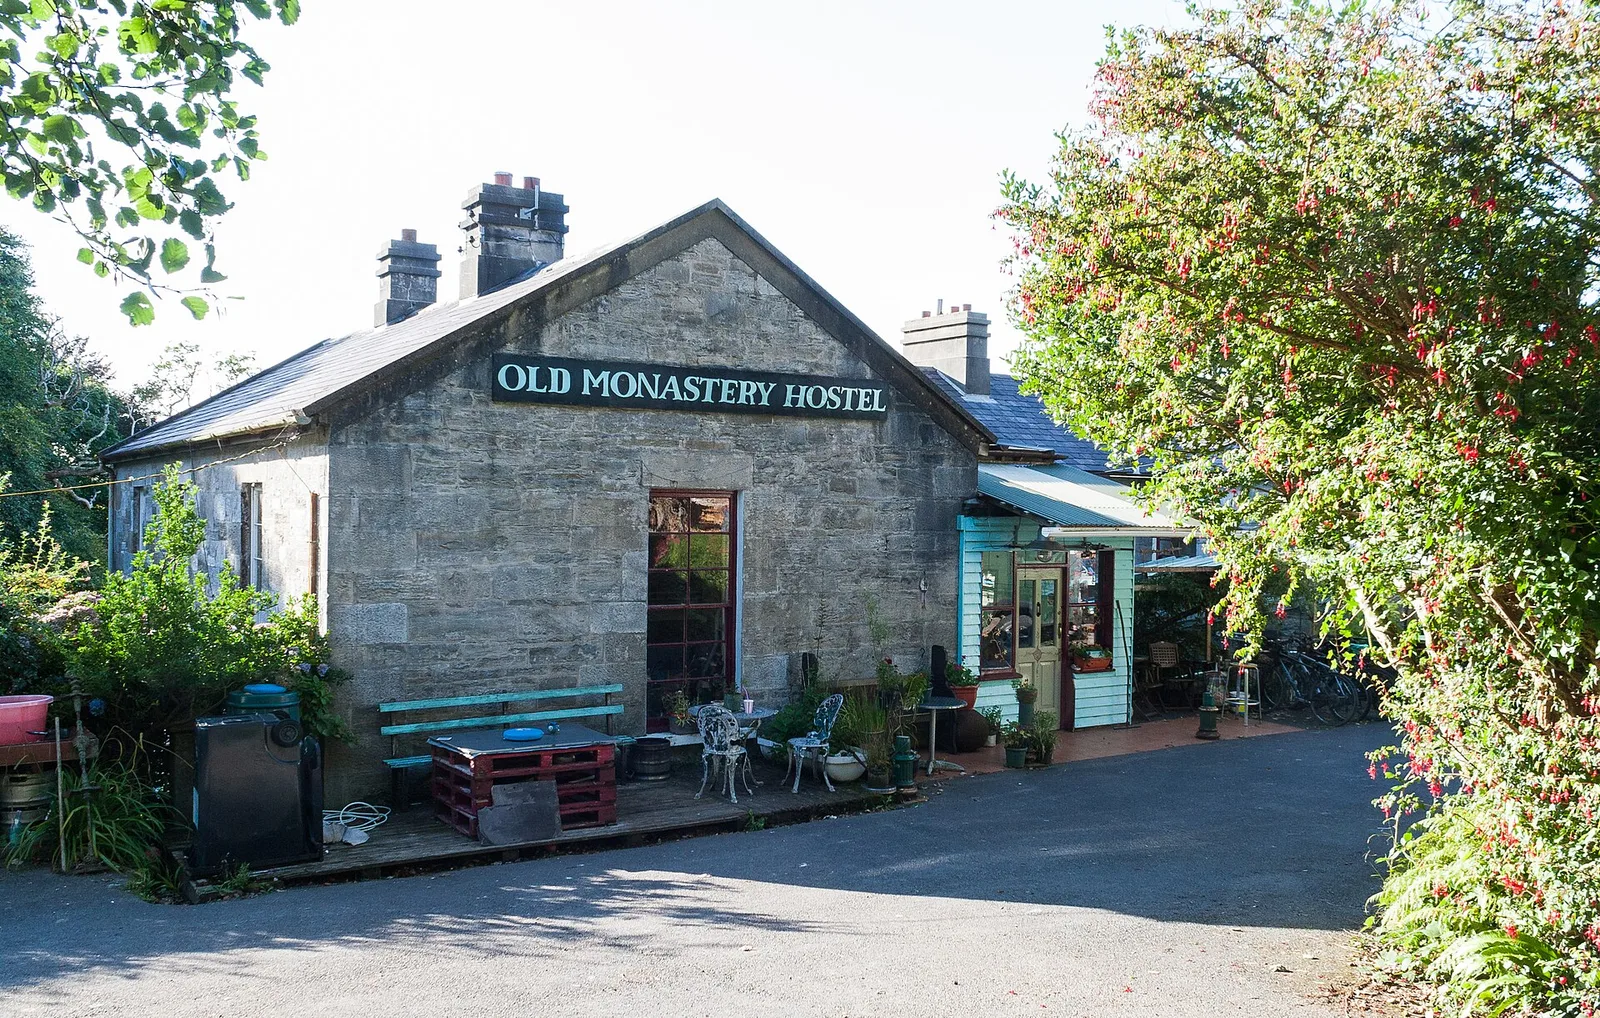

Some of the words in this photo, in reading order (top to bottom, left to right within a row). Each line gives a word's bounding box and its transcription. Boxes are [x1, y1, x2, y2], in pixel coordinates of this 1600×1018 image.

[498, 364, 570, 393] OLD
[582, 368, 778, 406] MONASTERY
[783, 385, 887, 411] HOSTEL
